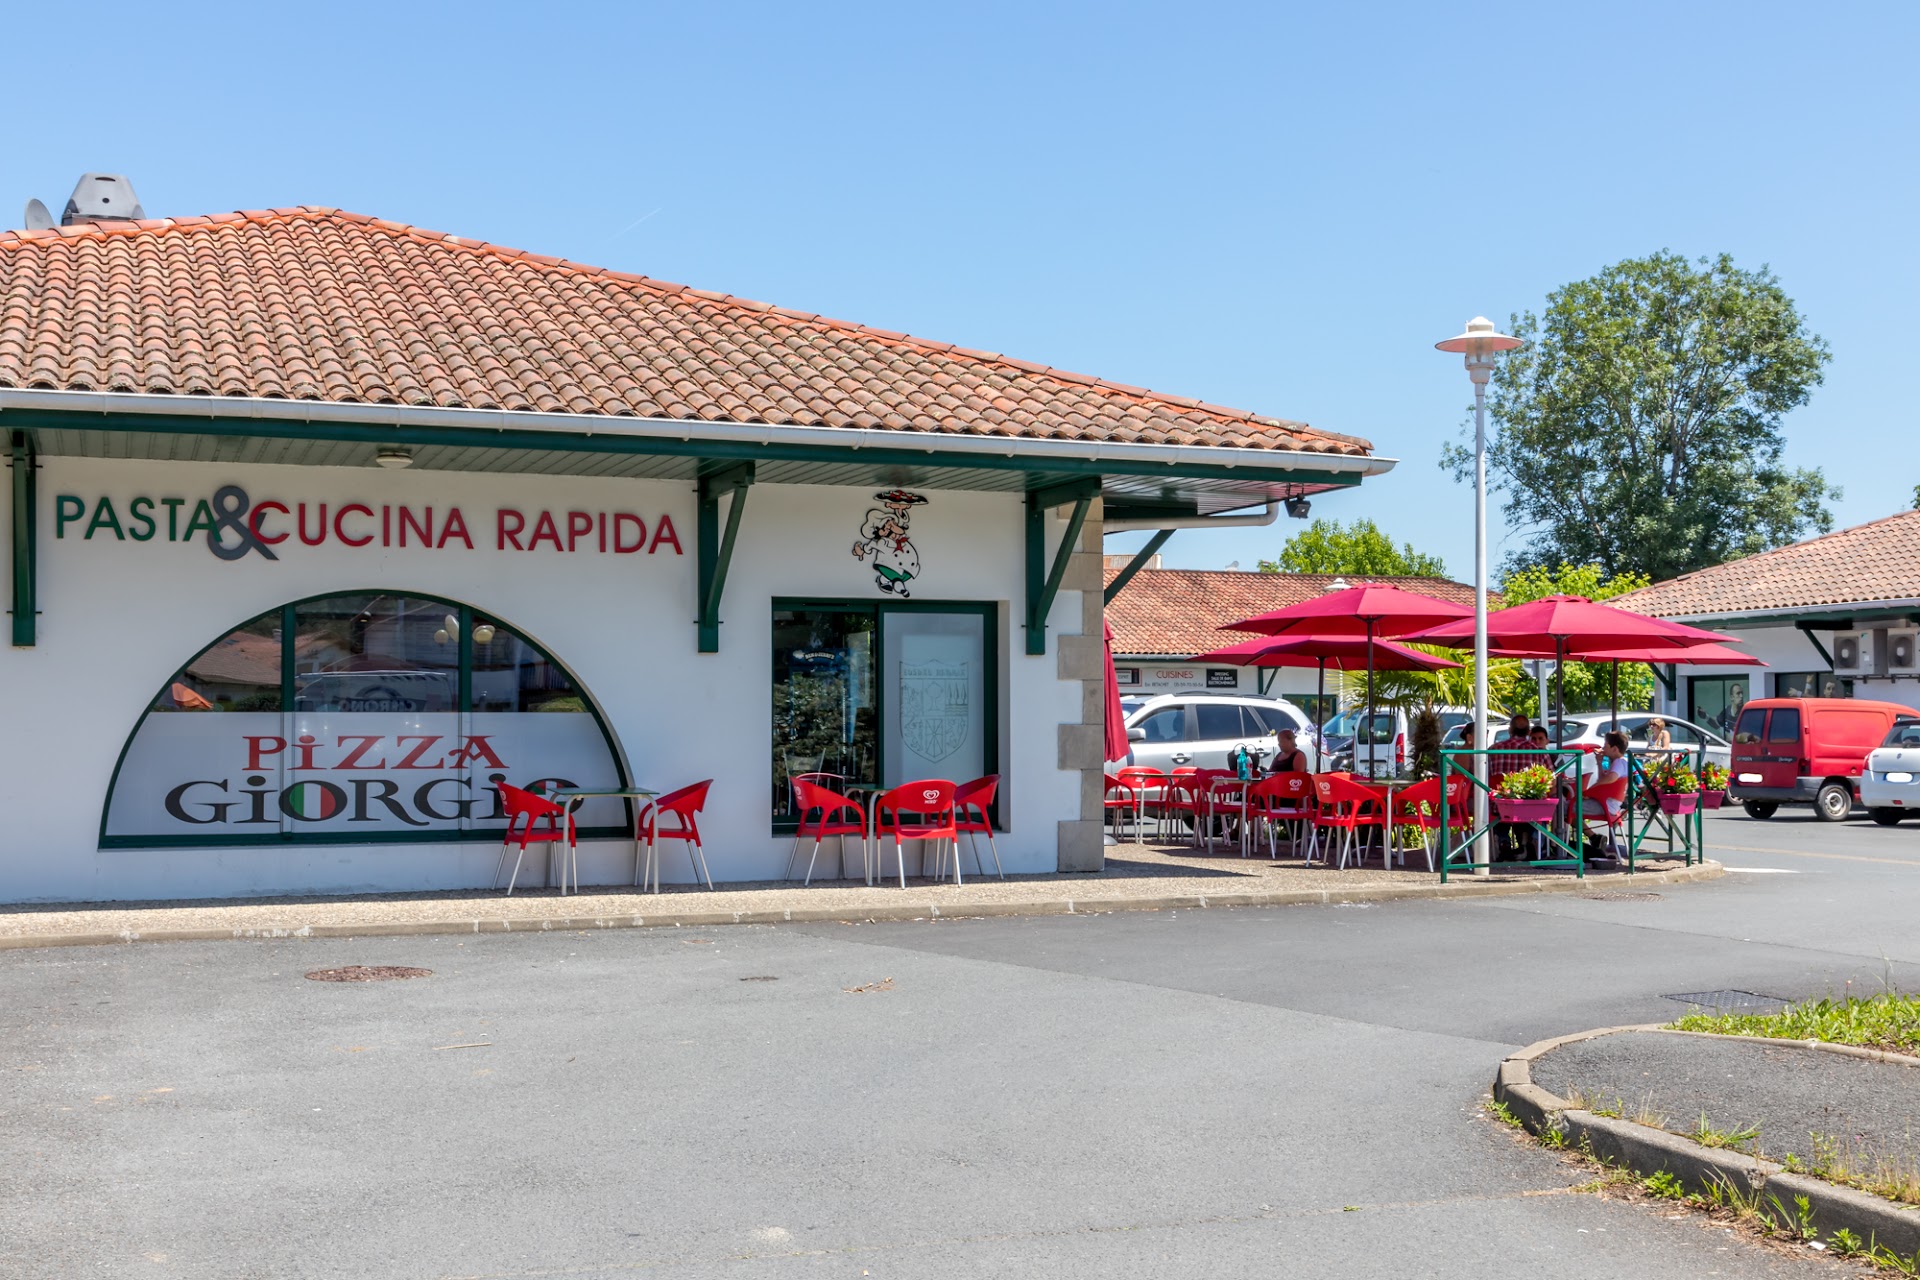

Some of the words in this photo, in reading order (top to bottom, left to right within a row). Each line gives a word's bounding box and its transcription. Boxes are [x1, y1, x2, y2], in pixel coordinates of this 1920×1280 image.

[55, 494, 224, 543] PASTA
[249, 499, 475, 550] CUCINA
[496, 508, 684, 556] RAPIDA
[1155, 670, 1194, 679] CUISINES
[241, 734, 511, 771] PiZZA
